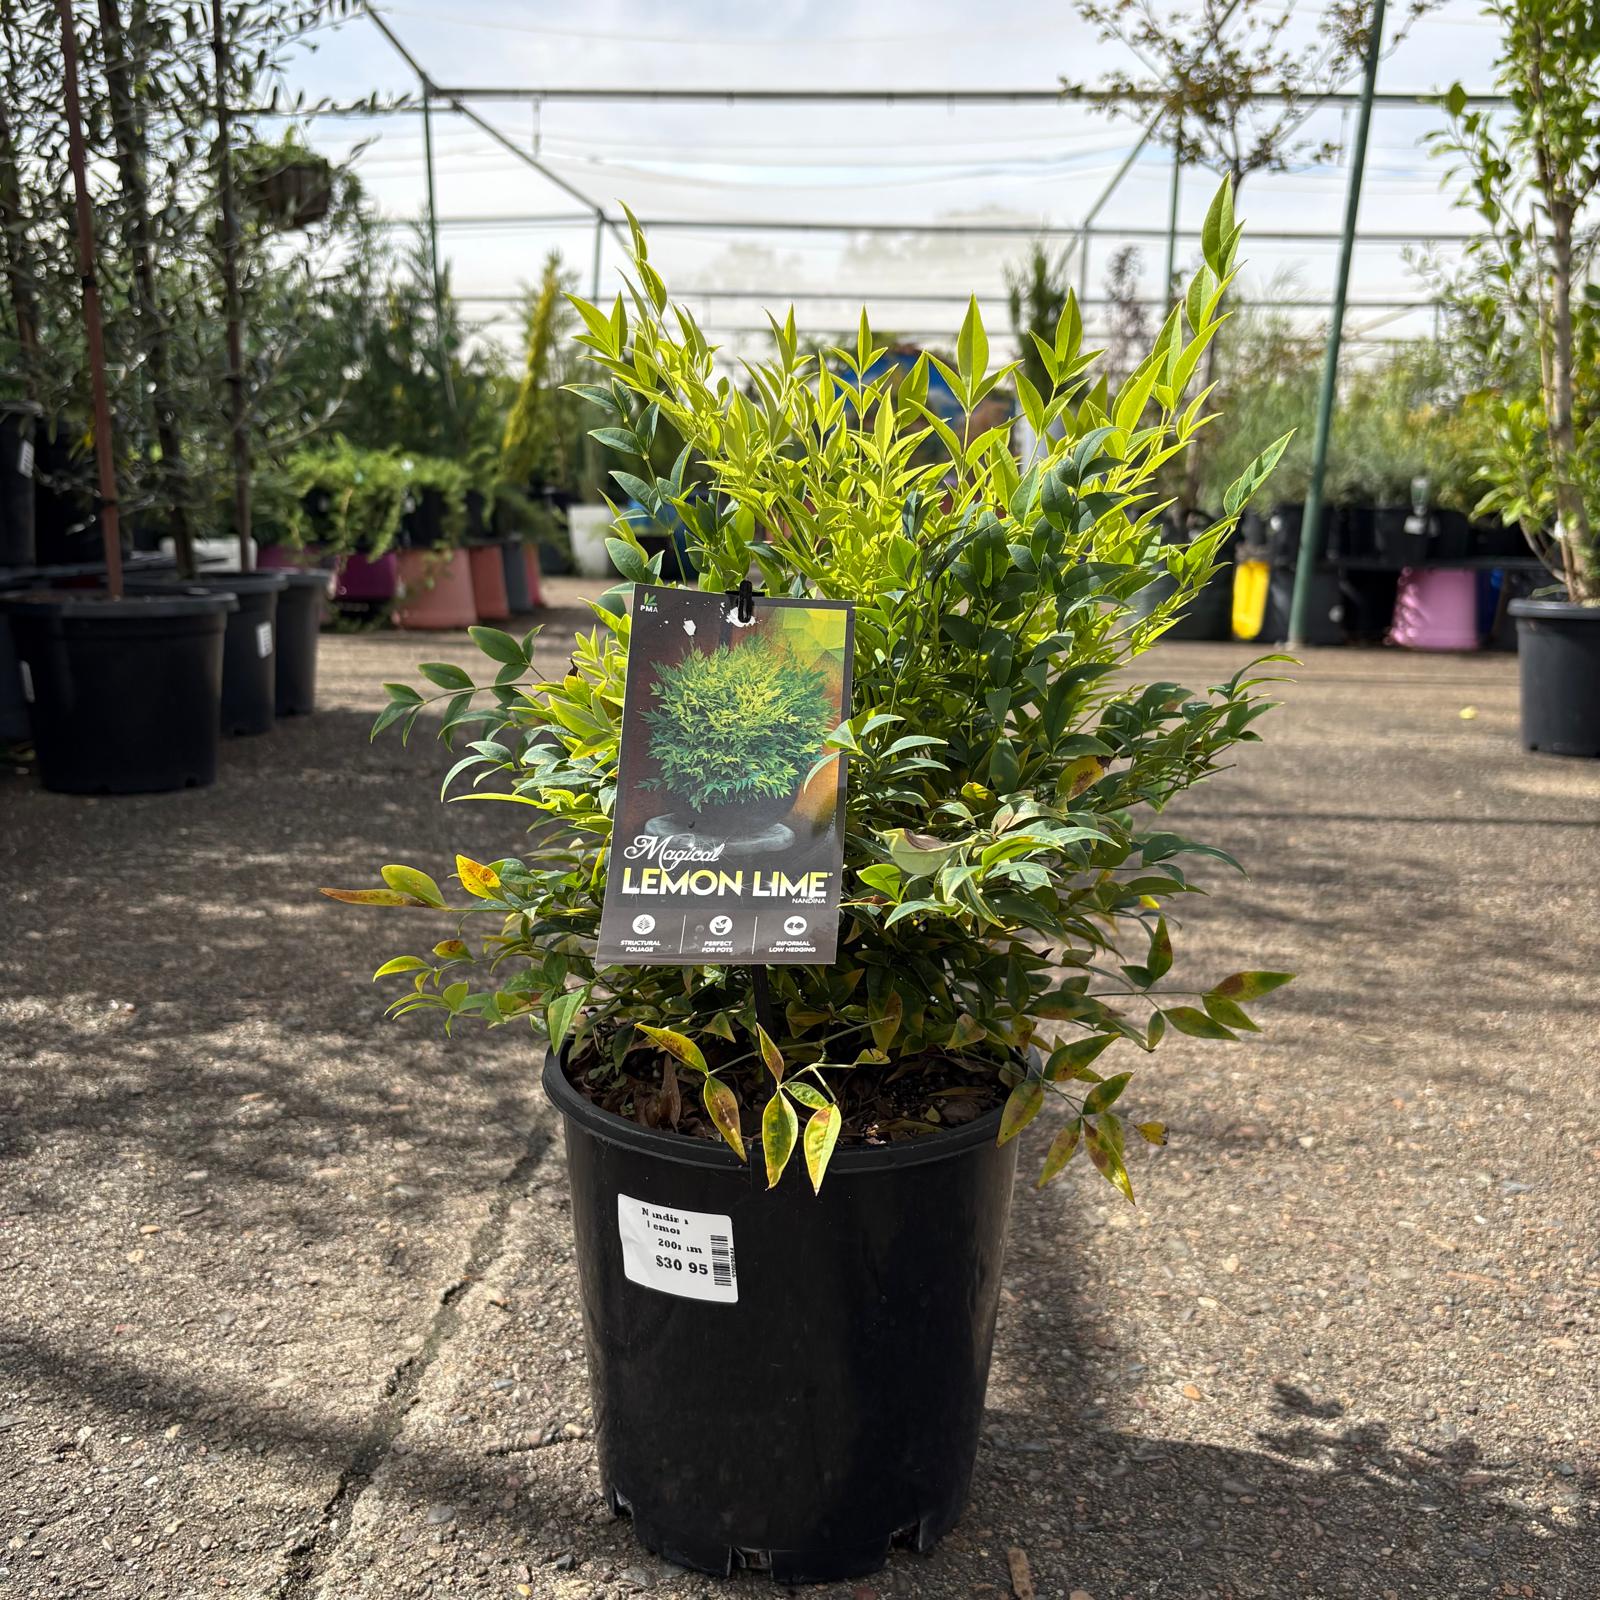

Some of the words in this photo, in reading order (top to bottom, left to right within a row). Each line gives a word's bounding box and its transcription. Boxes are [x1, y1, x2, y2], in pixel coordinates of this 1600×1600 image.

[640, 604, 658, 613] PMA
[624, 835, 725, 872] Magical
[622, 867, 743, 896] LEMON
